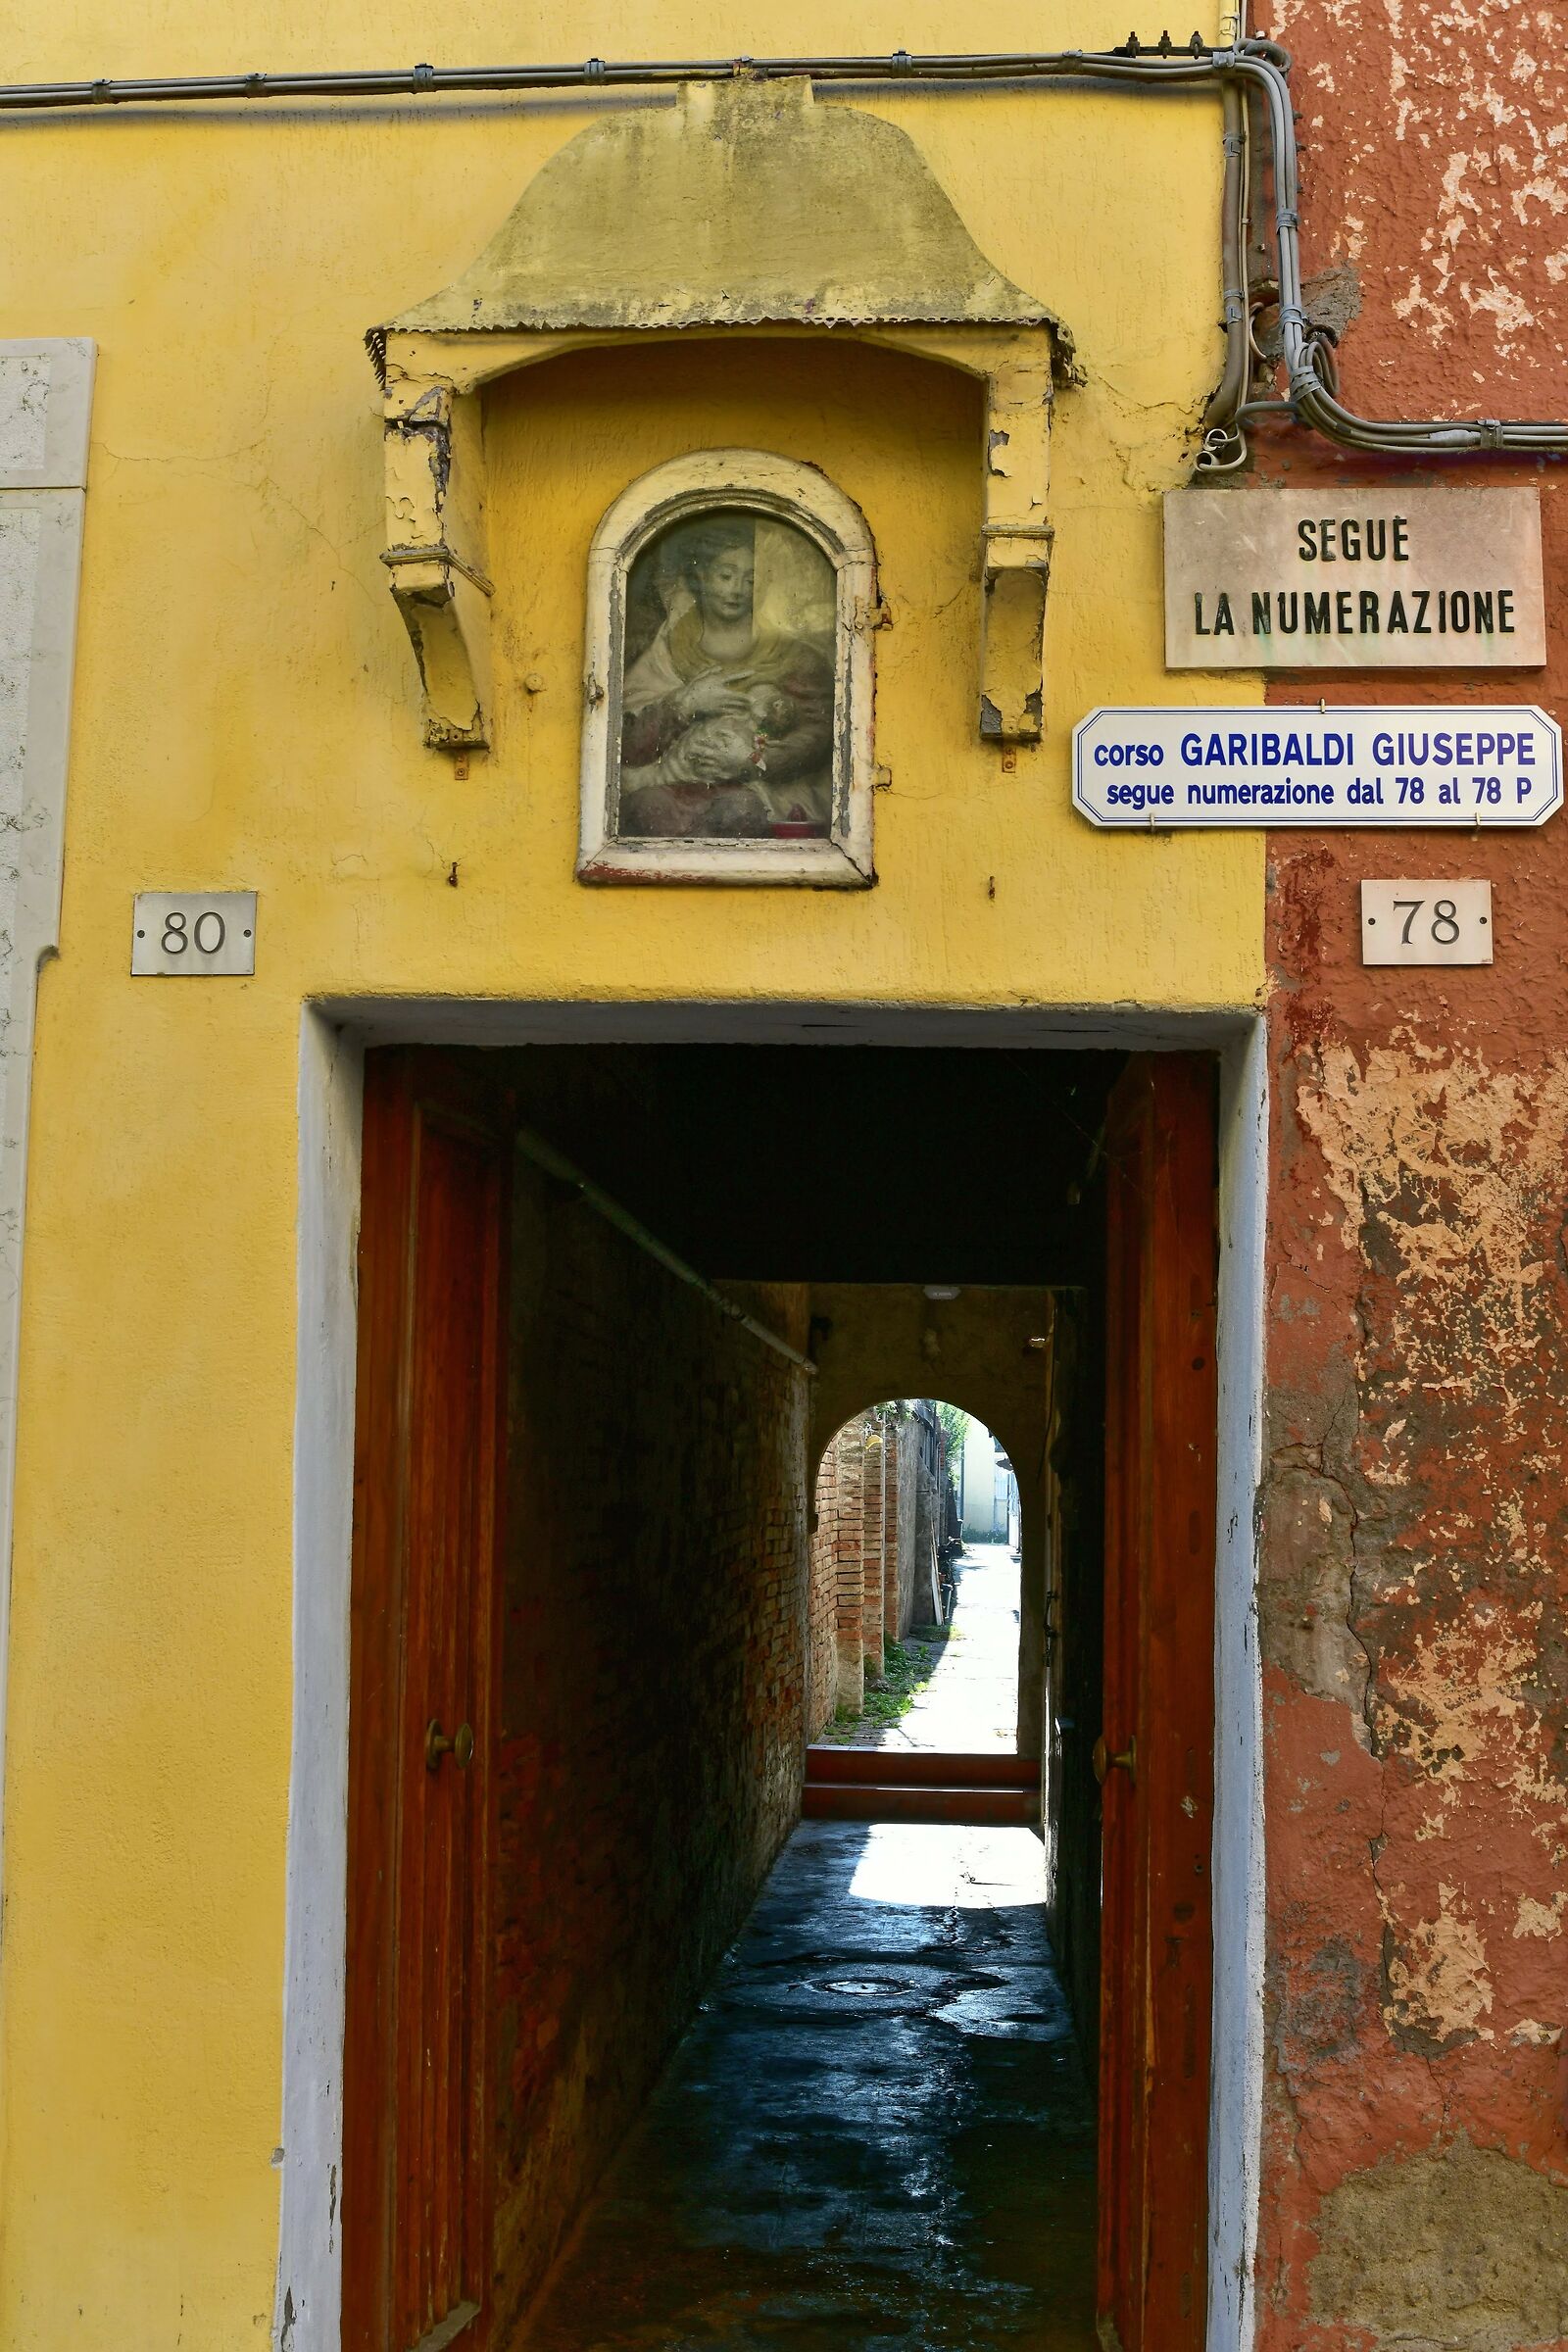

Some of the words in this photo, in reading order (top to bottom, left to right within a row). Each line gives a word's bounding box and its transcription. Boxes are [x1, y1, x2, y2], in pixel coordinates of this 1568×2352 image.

[1298, 517, 1409, 562] SEGUE
[1194, 592, 1235, 635] LA
[1250, 589, 1515, 634] NUMERAZIONE
[1094, 744, 1164, 767] corso
[1180, 732, 1353, 767] GARIBALDI
[1372, 732, 1536, 766] GIUSEPPE
[1105, 784, 1175, 810] segue
[1187, 777, 1335, 805] numerazione
[1347, 777, 1385, 805] dal
[1395, 777, 1425, 805] 78
[1438, 777, 1461, 805] al
[1472, 776, 1502, 805] 78
[1516, 777, 1532, 804] P
[161, 911, 226, 955] 80
[1393, 899, 1460, 945] 78
